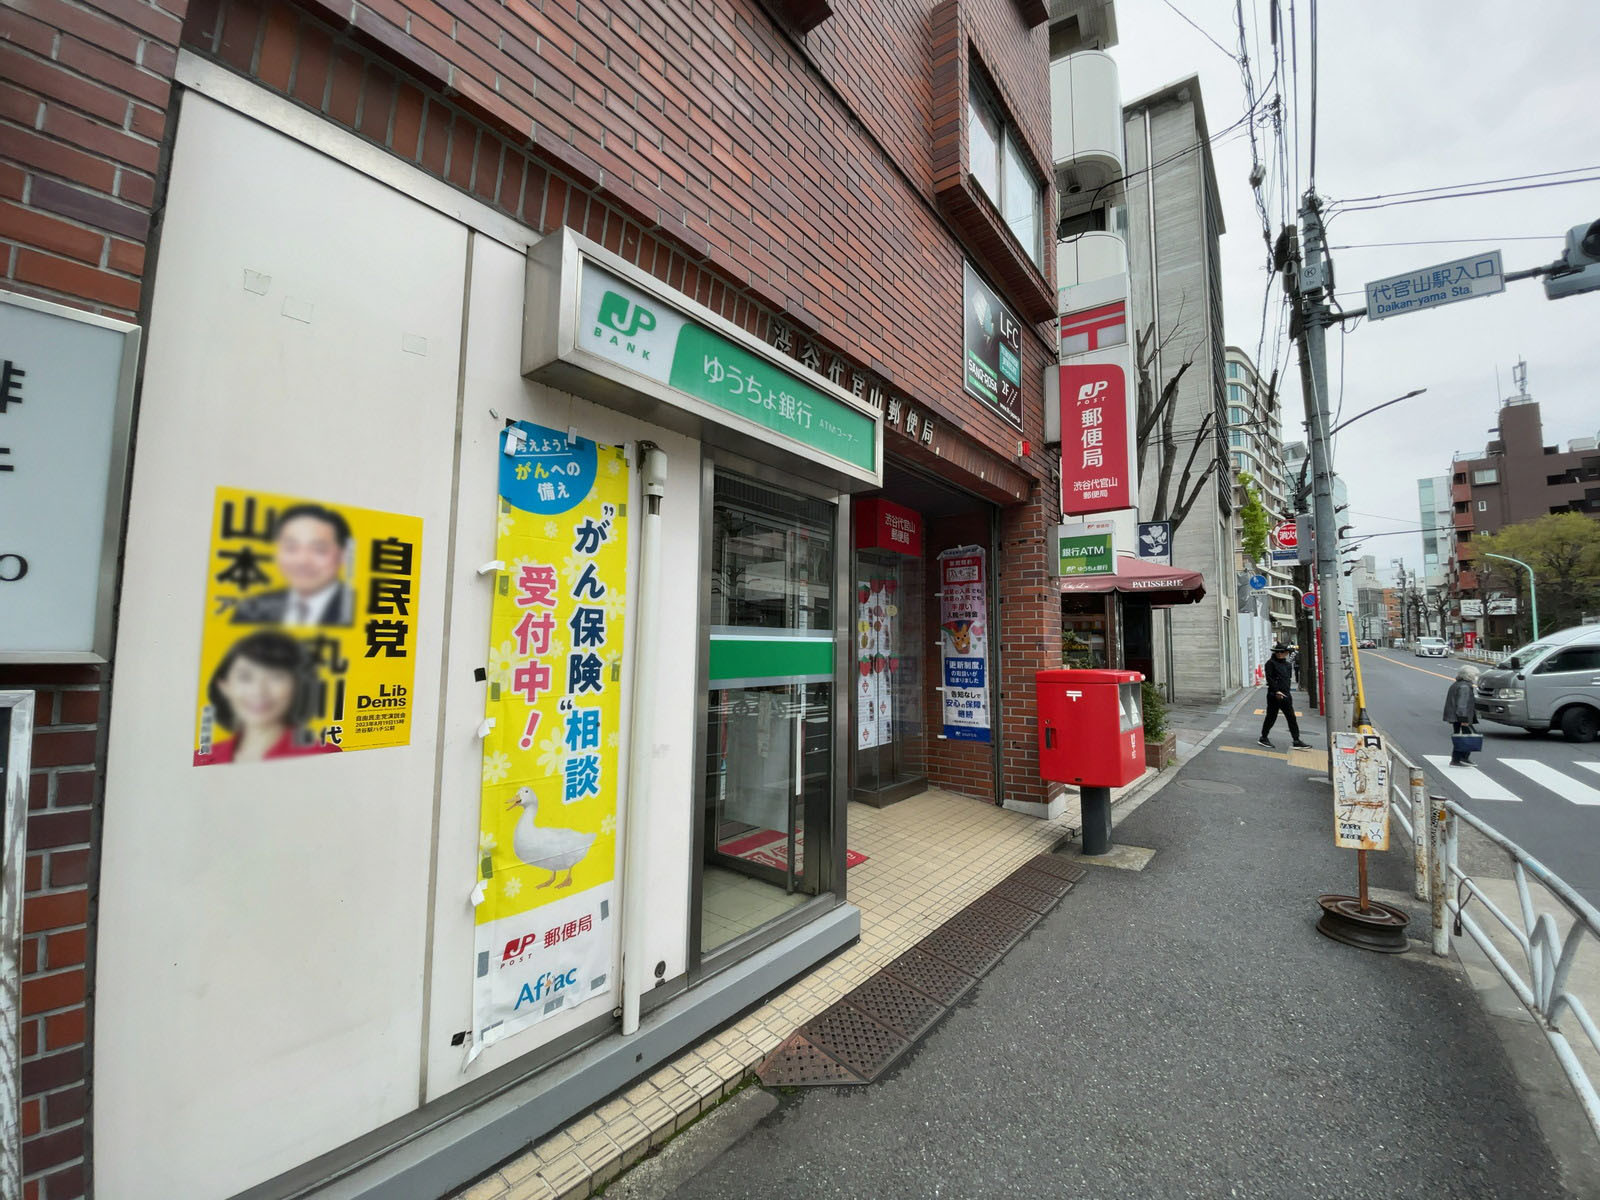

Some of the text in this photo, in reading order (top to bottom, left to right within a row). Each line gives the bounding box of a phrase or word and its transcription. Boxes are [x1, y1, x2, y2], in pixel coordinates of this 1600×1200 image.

[1373, 259, 1494, 303] 代官山駅入口
[1377, 285, 1473, 314] Daikan-yama Sta.
[597, 290, 656, 337] JP
[1000, 311, 1018, 349] LFC
[593, 326, 650, 360] BANK
[703, 354, 813, 429] ゆうちょ銀行
[774, 325, 934, 445] 渋谷代官山郵便局
[1078, 380, 1108, 400] JP
[1077, 396, 1107, 407] POST
[1081, 407, 1104, 469] 郵便局
[515, 461, 581, 480] がんへの
[537, 481, 570, 501] 備え
[1073, 477, 1118, 491] 渋谷代官山
[1083, 490, 1108, 500] 郵便局
[1279, 530, 1297, 541] 消火
[1062, 545, 1104, 557] 銀行ATM
[1132, 579, 1184, 588] PATISSERIE
[364, 537, 413, 658] 自民党
[379, 684, 407, 697] Lib
[357, 695, 407, 709] Dems
[502, 914, 592, 962] JP 郵便局
[500, 953, 533, 969] POST
[513, 968, 577, 1011] Aflac
